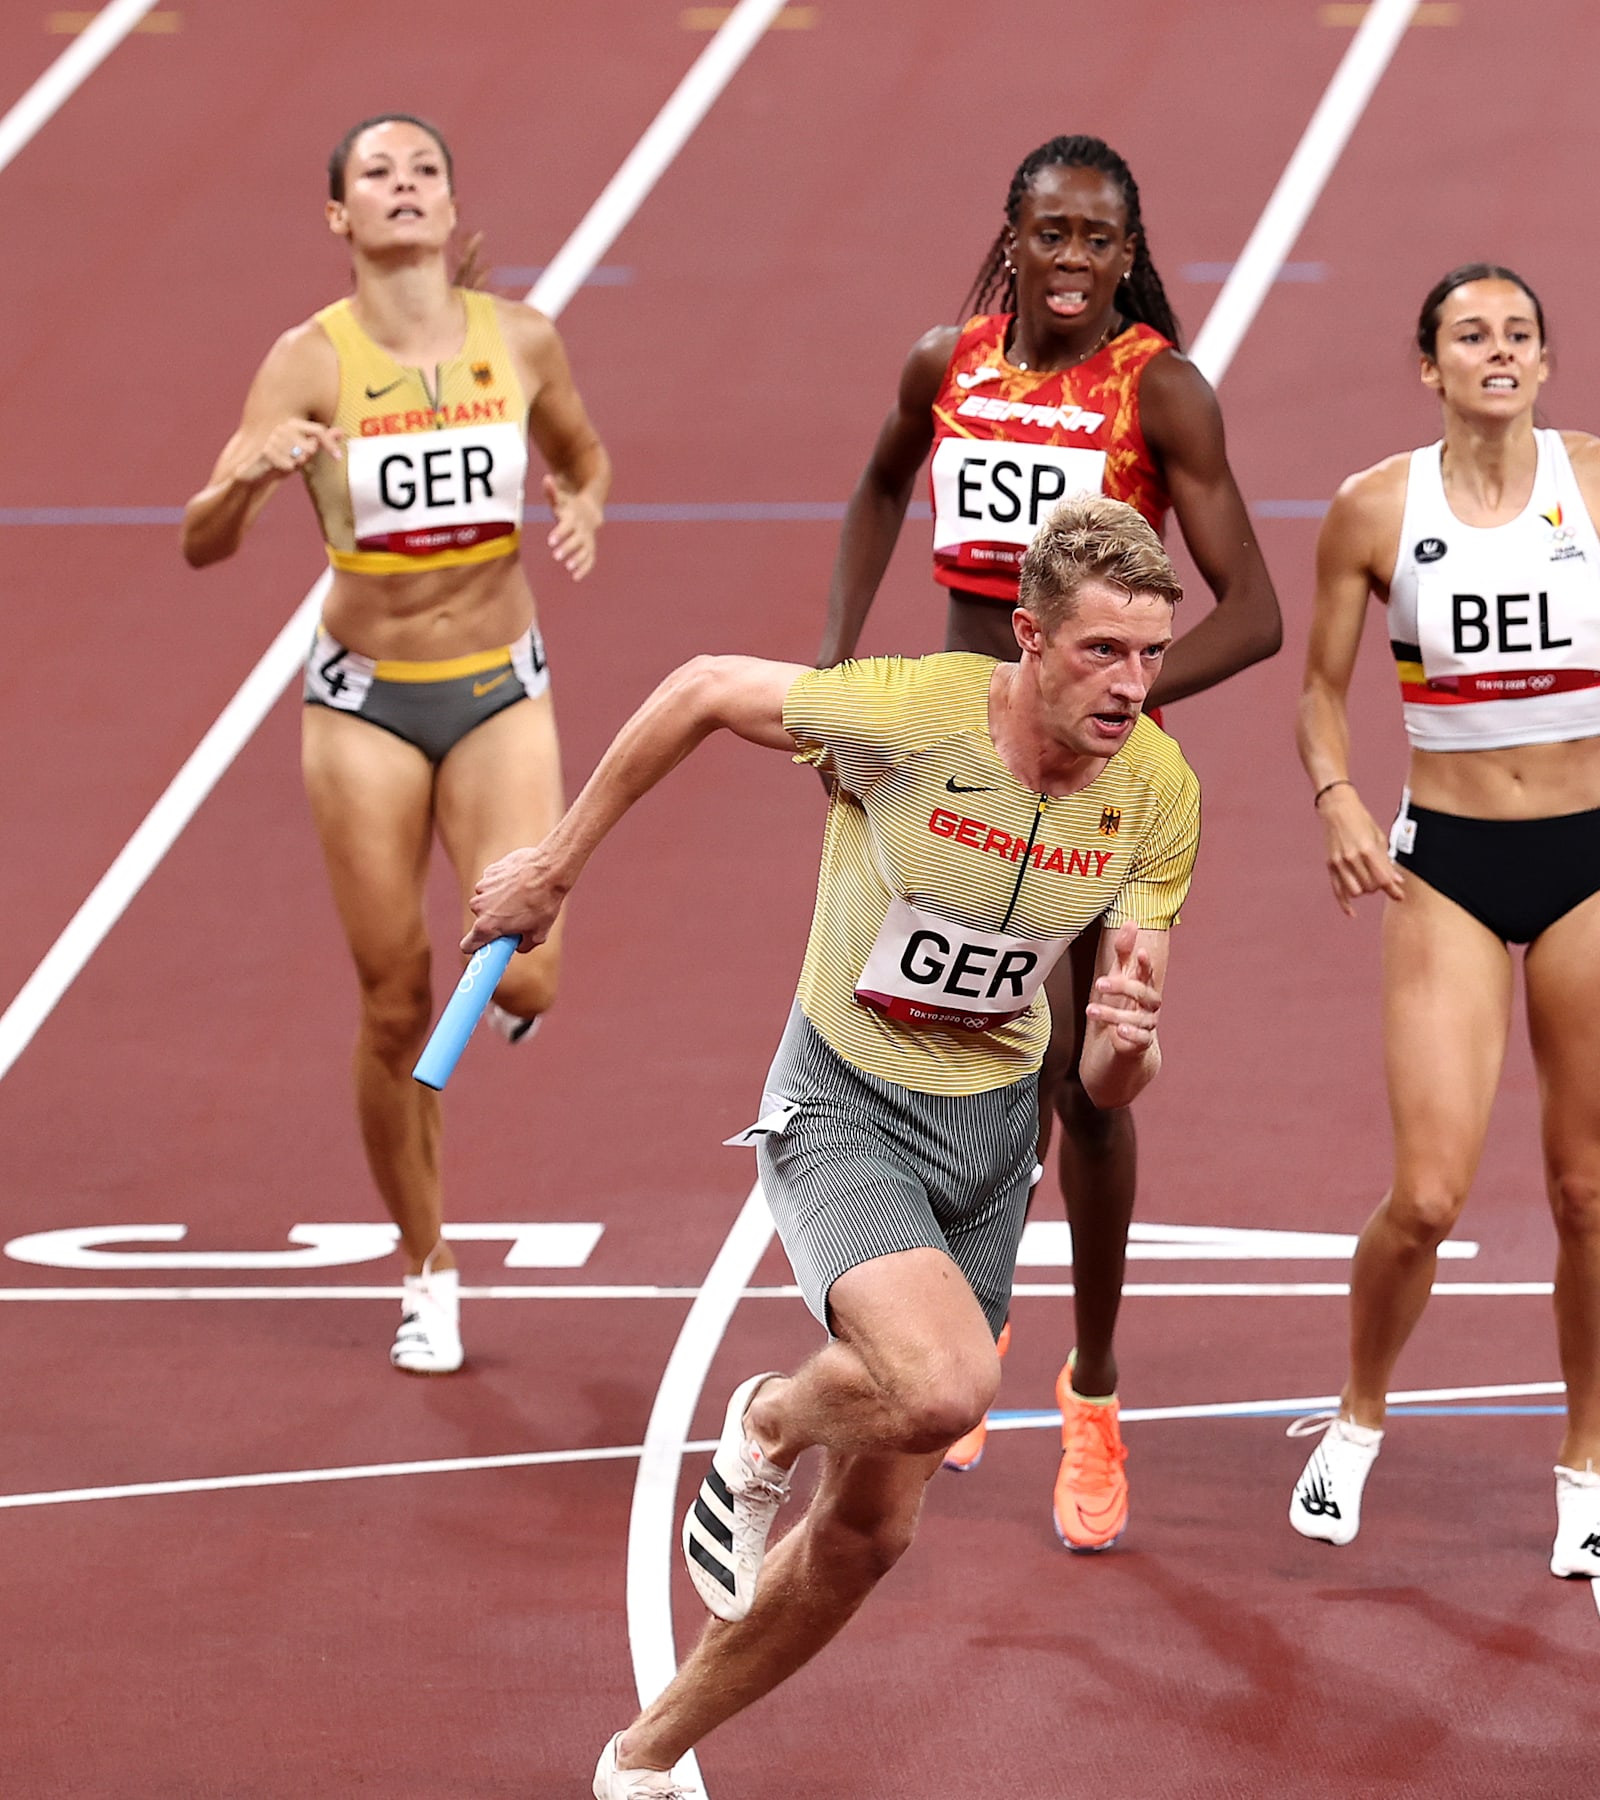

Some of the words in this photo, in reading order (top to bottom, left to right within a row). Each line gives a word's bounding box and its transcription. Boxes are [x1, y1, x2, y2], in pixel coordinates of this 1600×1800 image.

[360, 398, 506, 437] GERMANY
[956, 394, 1106, 435] ESPAÑA
[378, 446, 494, 510] GER
[957, 457, 1067, 526] ESP
[1451, 591, 1573, 655] BEL
[320, 648, 349, 697] 4
[928, 807, 1114, 878] GERMANY
[899, 929, 1038, 1000] GER
[909, 1007, 938, 1020] TOKYO
[938, 1014, 961, 1023] 2020
